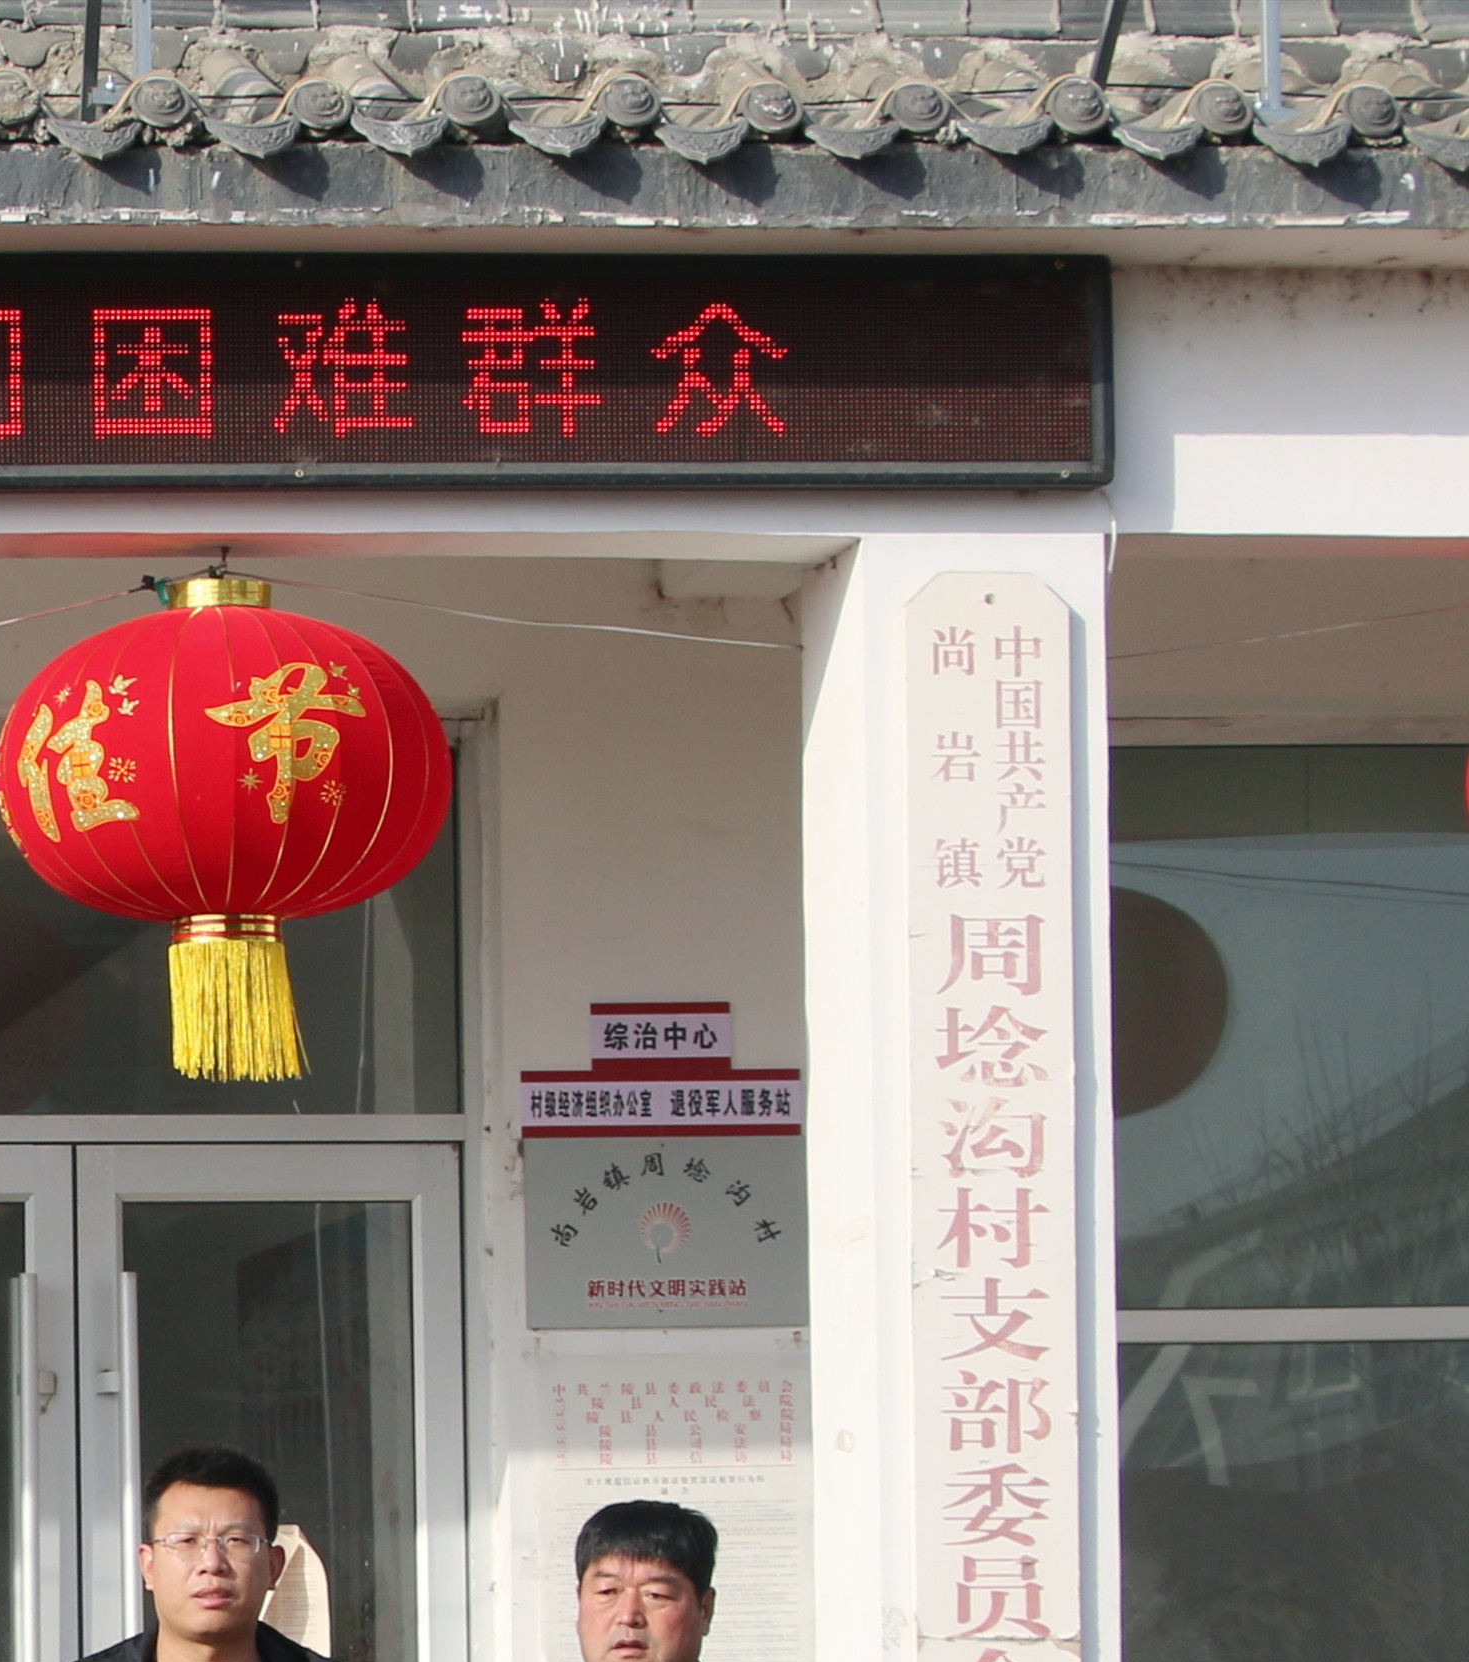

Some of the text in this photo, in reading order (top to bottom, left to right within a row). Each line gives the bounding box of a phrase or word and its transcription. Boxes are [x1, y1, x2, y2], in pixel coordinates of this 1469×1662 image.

[930, 625, 985, 890] 尚岩镇
[993, 625, 1048, 890] 中国共产党
[603, 1021, 719, 1051] 综治中心
[531, 1089, 653, 1118] 村级经济组织办公室
[670, 1088, 792, 1118] 退役军人服务站
[587, 1278, 748, 1299] 新时代文明实践站
